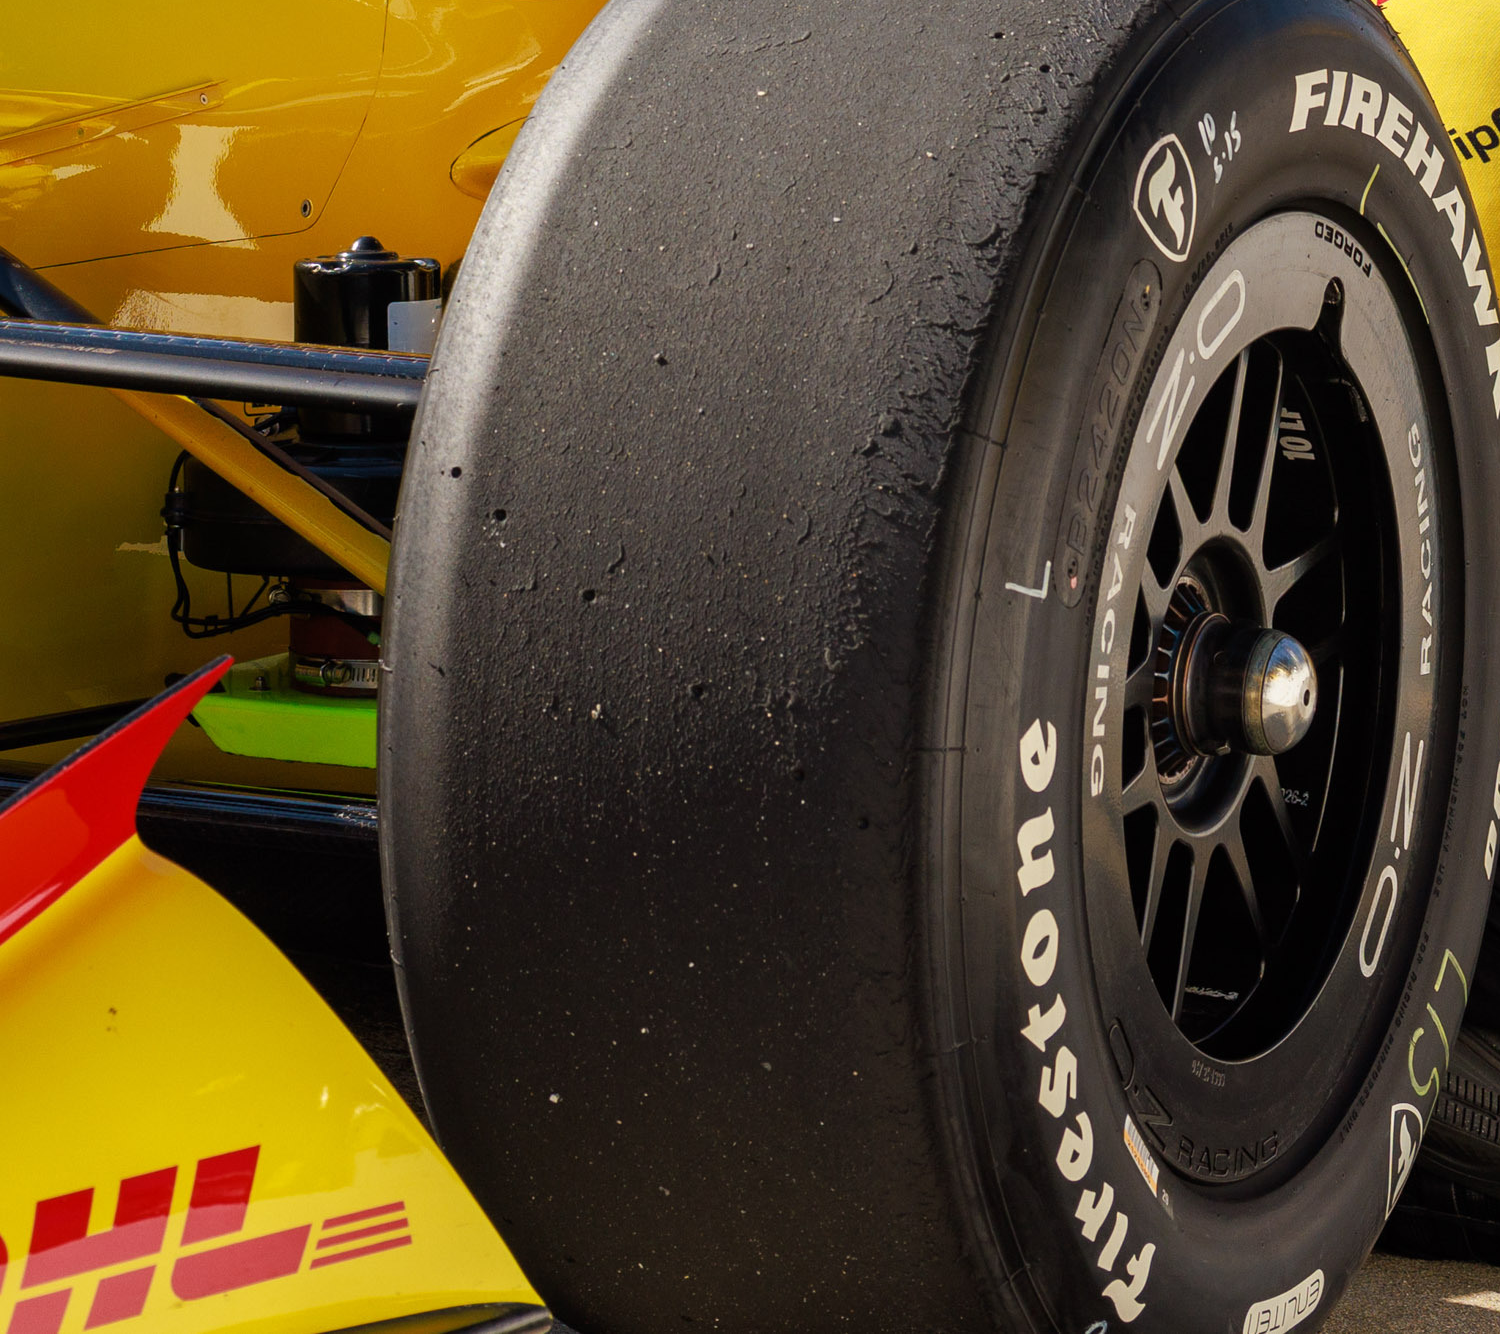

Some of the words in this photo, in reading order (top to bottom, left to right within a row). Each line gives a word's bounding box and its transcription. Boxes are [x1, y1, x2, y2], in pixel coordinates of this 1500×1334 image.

[1313, 220, 1373, 279] FORGED
[1089, 503, 1137, 799] RACING
[1407, 422, 1433, 677] RACING
[1016, 717, 1158, 1324] Firestone
[1176, 1128, 1280, 1179] RACING
